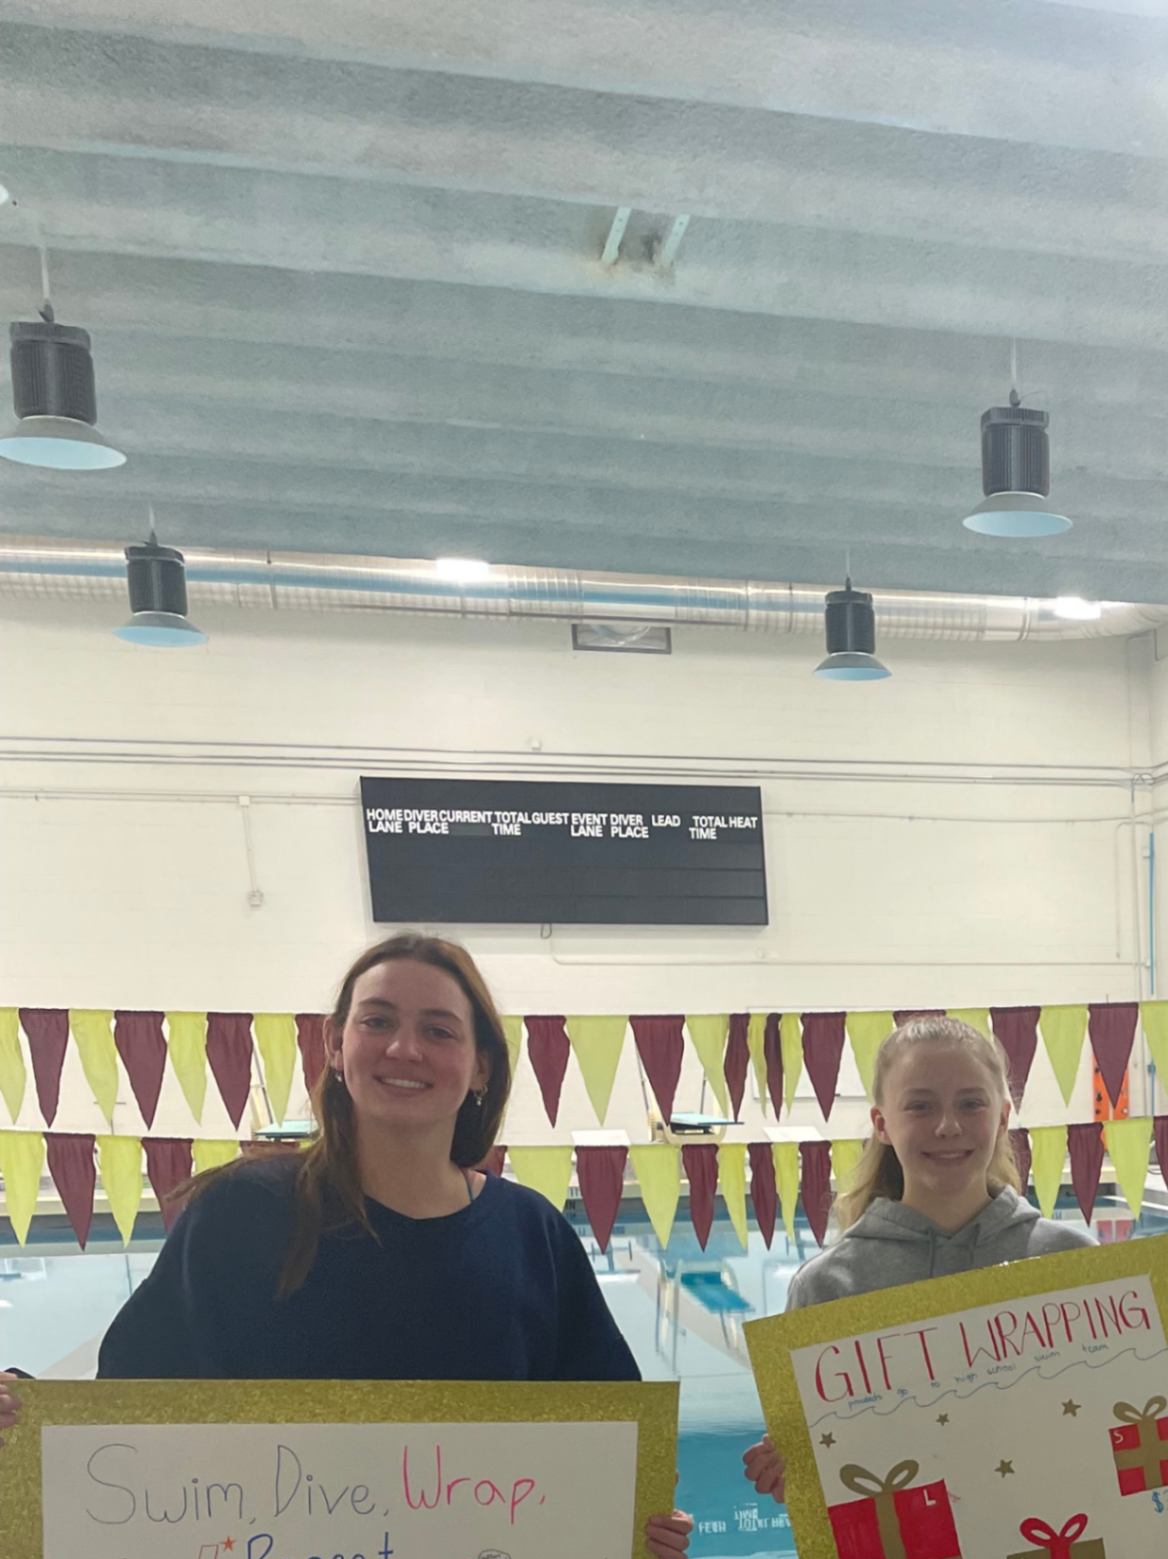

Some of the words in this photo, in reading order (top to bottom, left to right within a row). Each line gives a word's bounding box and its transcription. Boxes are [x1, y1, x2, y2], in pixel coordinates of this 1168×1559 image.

[367, 809, 403, 821] HOME
[404, 810, 441, 822] DIVER
[439, 811, 493, 823] CURRENT
[494, 812, 533, 824] TOTAL
[532, 812, 569, 825] GUEST
[572, 813, 608, 826] EVENT
[610, 814, 643, 826] DIVER
[652, 815, 681, 827] LEAD
[692, 816, 728, 828] TOTAL
[729, 817, 758, 829] HEAT
[369, 821, 403, 833] LANE
[408, 822, 449, 834] PLACE
[491, 823, 521, 836] TIME
[571, 825, 603, 837] LANE
[611, 826, 649, 839] PLACE
[688, 827, 717, 840] TIME
[815, 1327, 938, 1402] GIFT
[959, 1290, 1152, 1368] WRAPPING
[987, 1362, 1017, 1375] school
[1082, 1342, 1109, 1354] team
[1113, 1431, 1124, 1443] S
[86, 1443, 256, 1525] Swim,
[274, 1444, 390, 1518] Dive,
[923, 1489, 936, 1506] L
